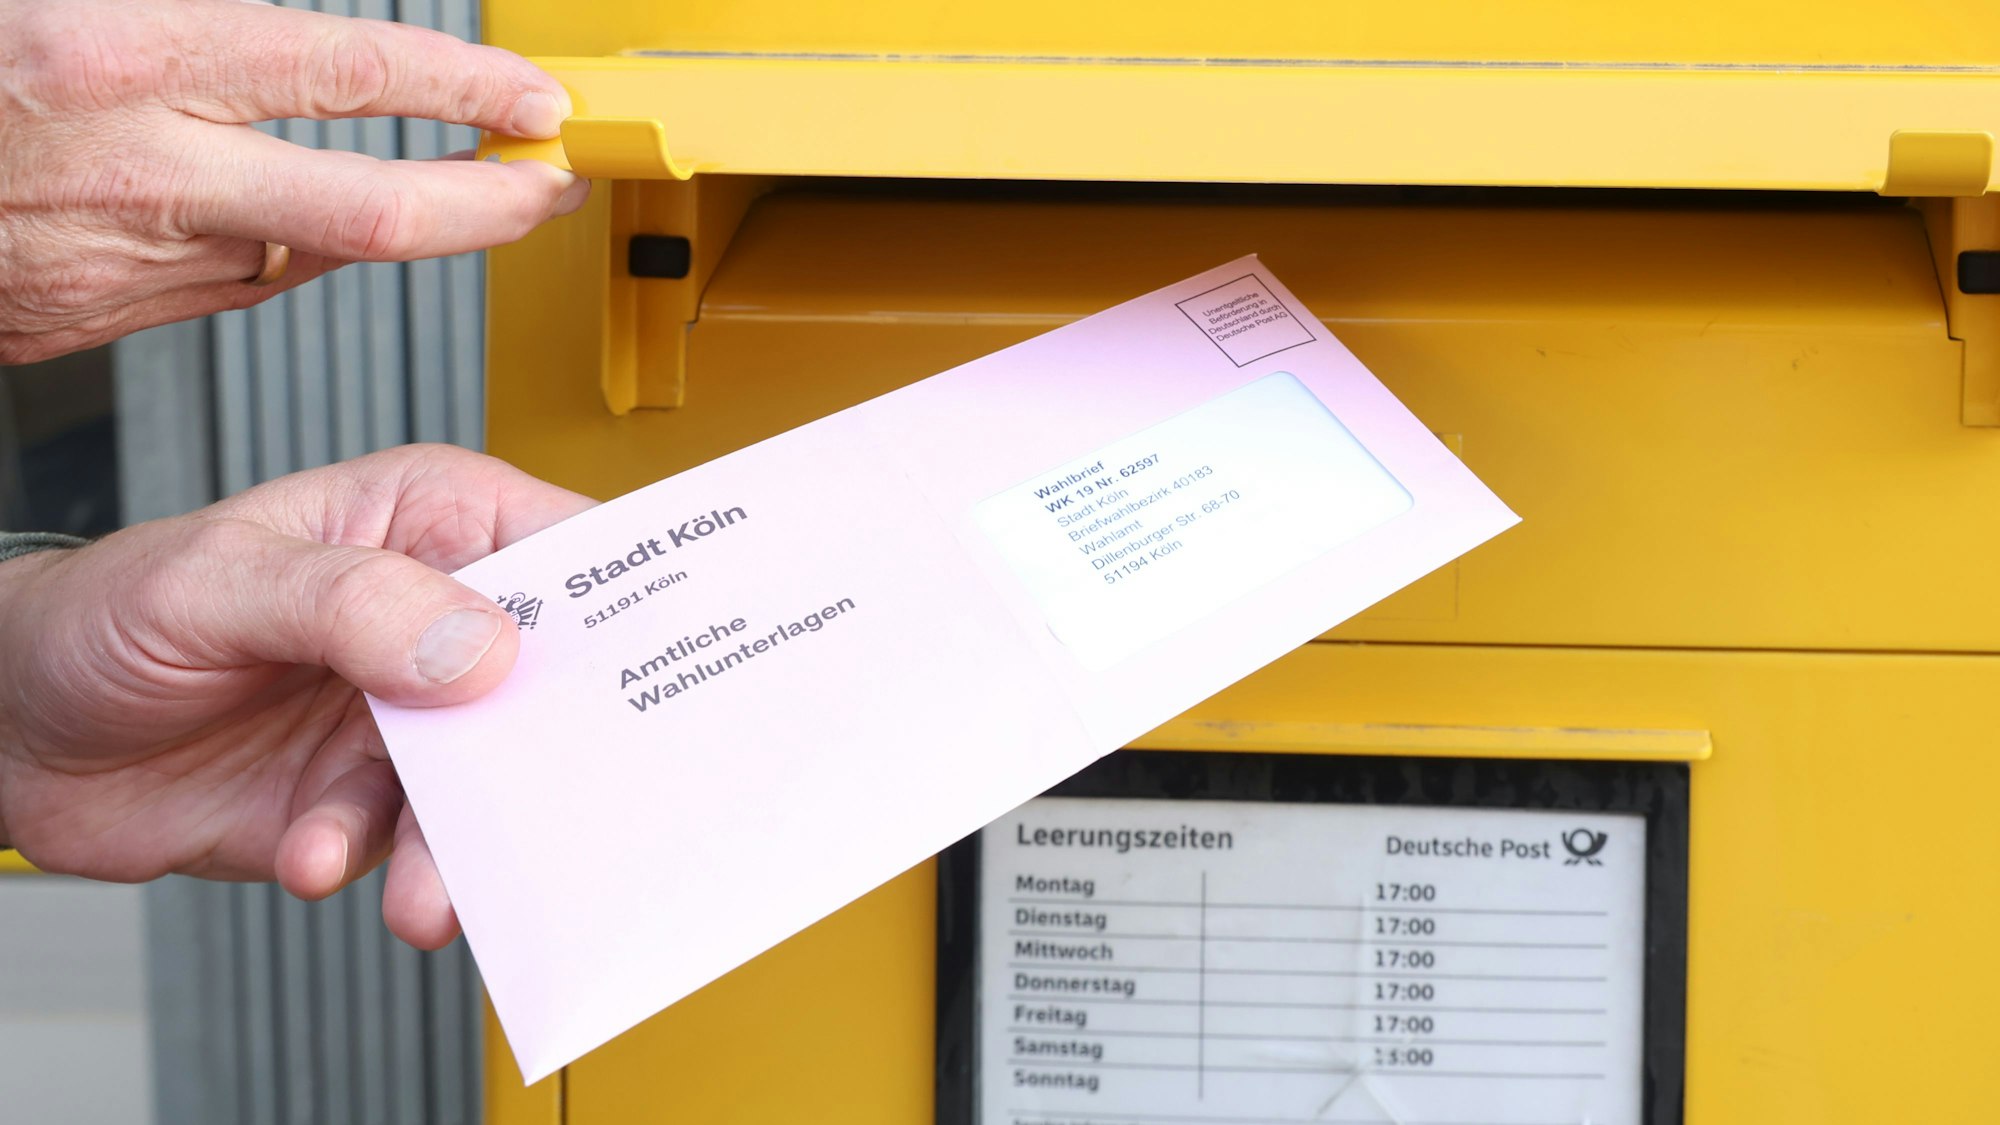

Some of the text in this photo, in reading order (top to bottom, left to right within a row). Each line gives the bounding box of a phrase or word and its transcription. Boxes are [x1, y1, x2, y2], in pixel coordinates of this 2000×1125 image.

[1203, 292, 1259, 316] Unentgeltliche
[1209, 299, 1267, 325] Beförderung in
[1208, 304, 1281, 335] Deutschland durch
[1216, 311, 1288, 341] Deutsche Post AG
[1034, 460, 1105, 500] Wahlbrief
[1044, 453, 1160, 514] WK 19 Nr. 62597
[1056, 487, 1129, 528] Stadt Köln
[1067, 464, 1214, 543] Briefwahlbezirk 40183
[1079, 518, 1144, 556] Wahlamt
[1091, 489, 1241, 571] Dillenburger Str. 68-70
[564, 506, 748, 600] Stadt Köln
[1103, 538, 1184, 586] 51194 Köln
[583, 570, 689, 630] 51191 Köln
[618, 613, 748, 690] Amtliche
[627, 595, 857, 713] Wahlunterlagen
[1016, 824, 1234, 853] Leerungszeiten
[1385, 836, 1552, 859] Deutsche Post
[1014, 875, 1096, 897] Montag
[1375, 883, 1437, 902] 17:00
[1014, 909, 1108, 930] Dienstag
[1375, 917, 1436, 936] 17:00
[1014, 941, 1114, 962] Mittwoch
[1374, 950, 1436, 969] 17:00
[1013, 973, 1137, 997] Donnerstag
[1374, 983, 1435, 1001] 17:00
[1013, 1005, 1088, 1028] Freitag
[1373, 1016, 1435, 1034] 17:00
[1013, 1038, 1104, 1060] Samstag
[1013, 1070, 1101, 1093] Sonntag
